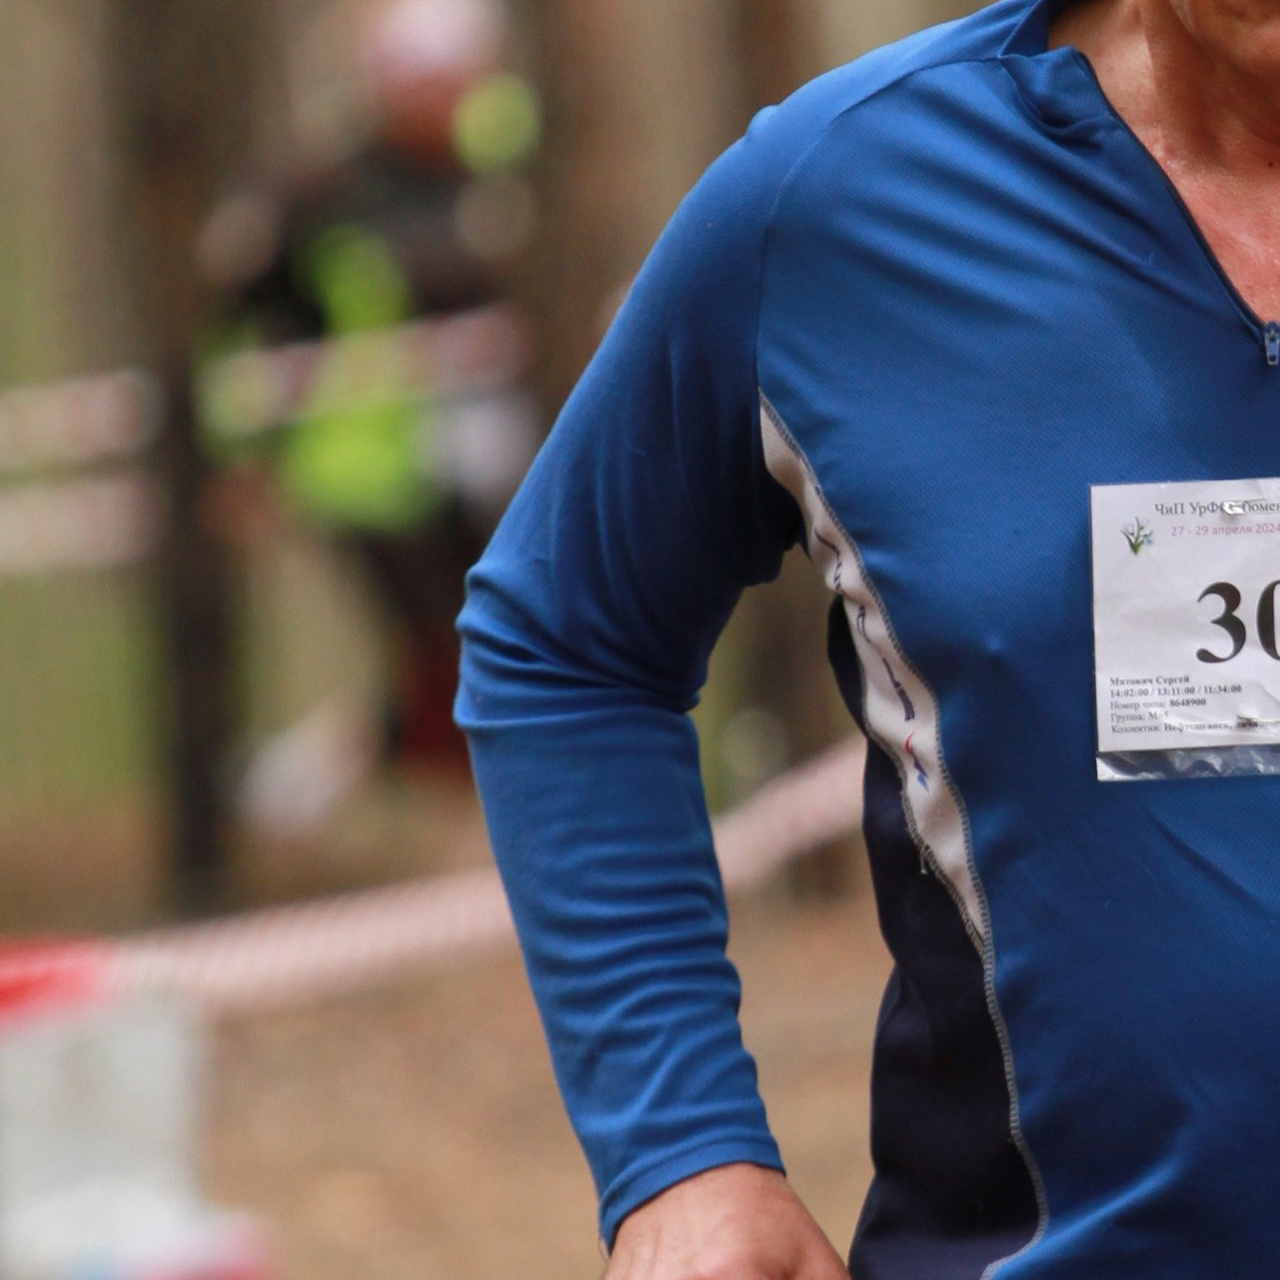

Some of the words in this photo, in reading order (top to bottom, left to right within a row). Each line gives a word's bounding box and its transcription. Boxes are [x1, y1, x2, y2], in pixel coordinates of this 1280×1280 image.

[1154, 502, 1184, 515] ЧиП
[1171, 526, 1184, 536] 27
[1195, 525, 1208, 536] 29
[1211, 526, 1252, 536] апреля
[1155, 675, 1189, 686] Сергей
[1110, 688, 1149, 698] 14:02:00
[1157, 686, 1195, 696] 13:11:00
[1203, 685, 1242, 694] 11:34:00
[1169, 698, 1207, 707] 8648900
